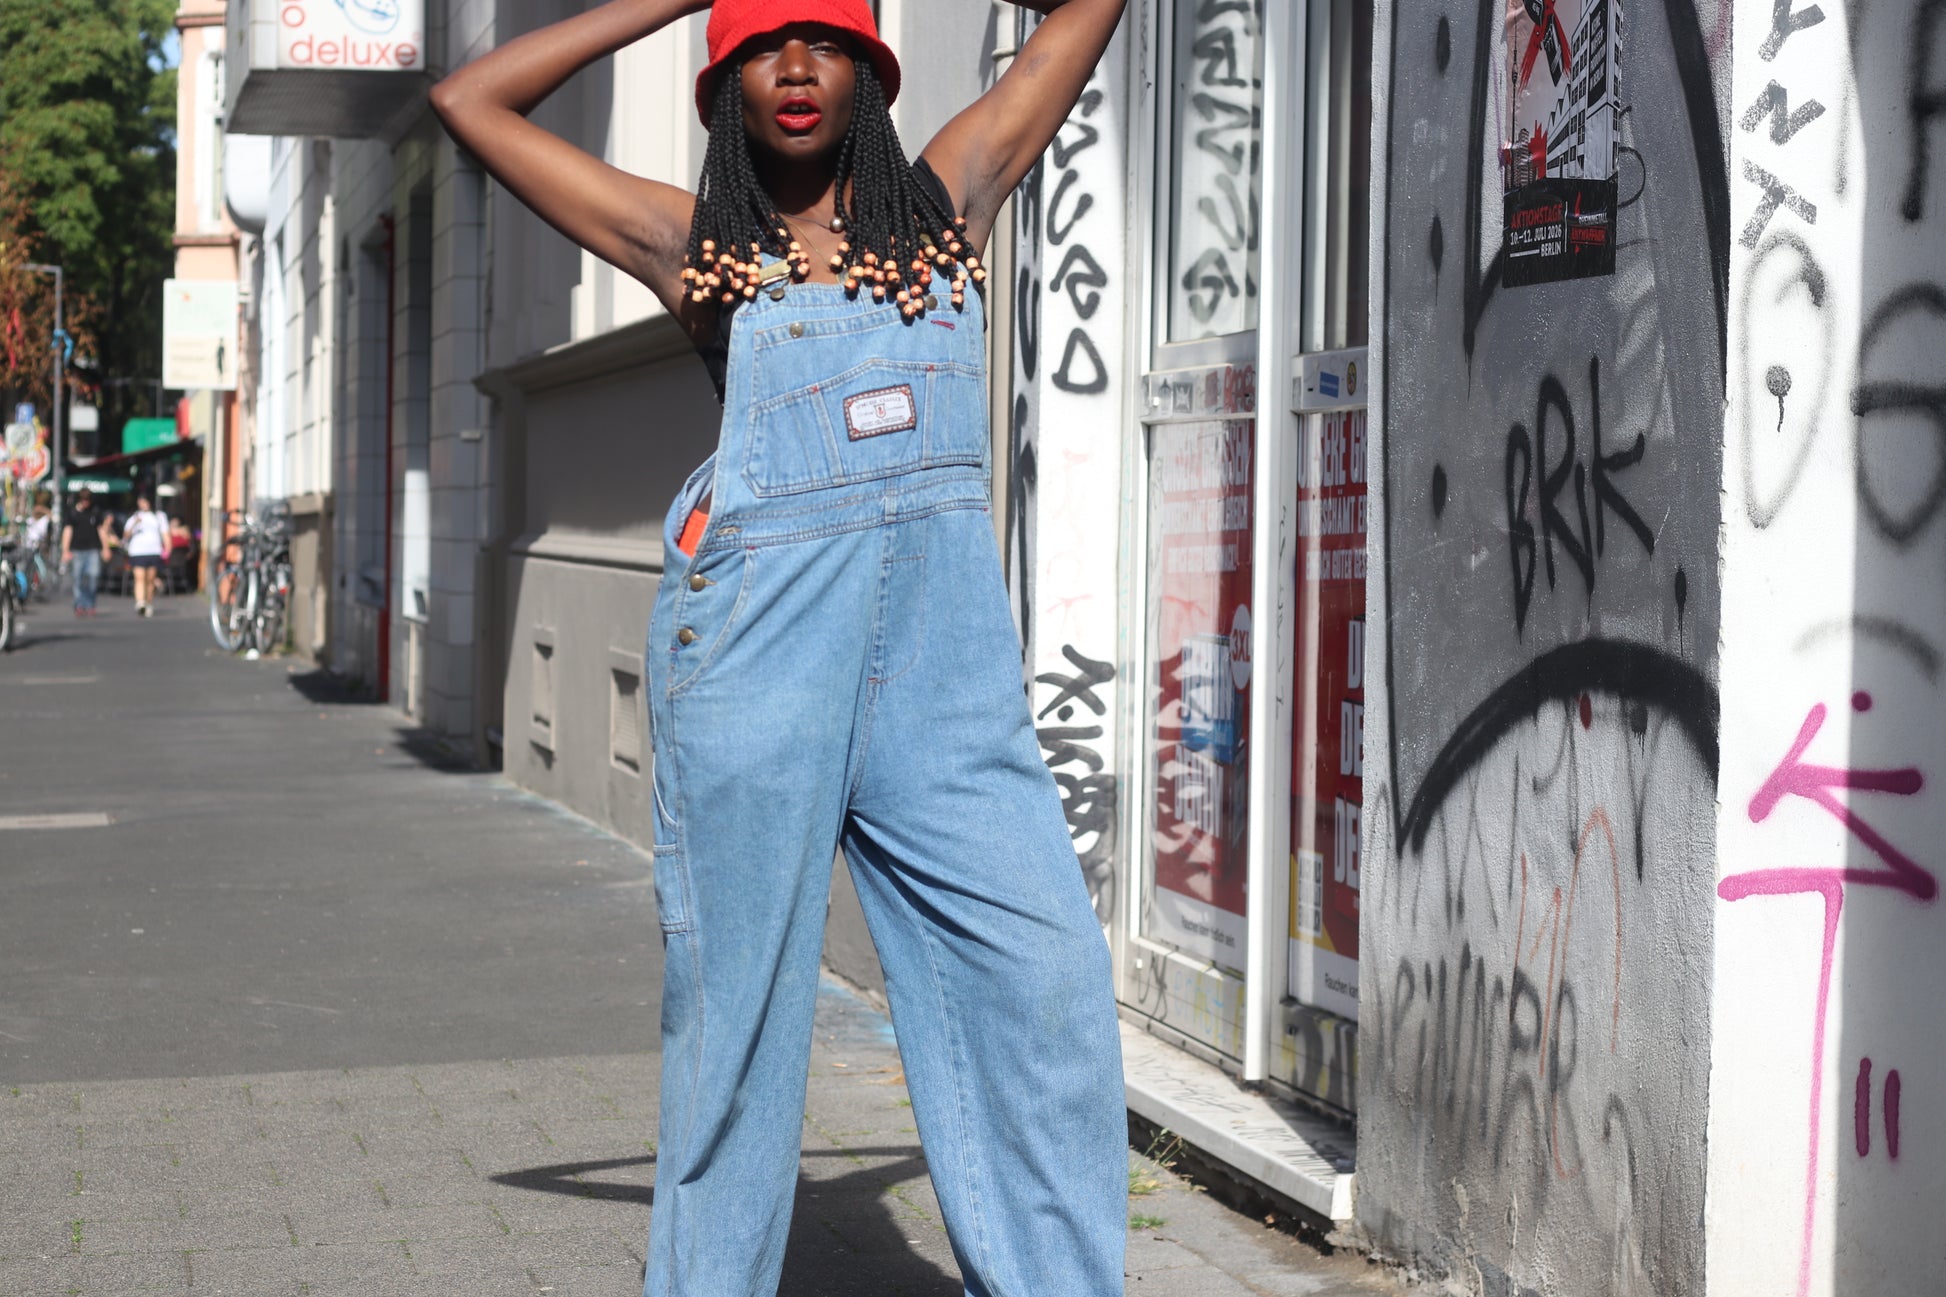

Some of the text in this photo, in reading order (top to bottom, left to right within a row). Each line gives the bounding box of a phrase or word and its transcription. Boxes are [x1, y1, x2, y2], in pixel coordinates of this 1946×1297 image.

[289, 34, 417, 66] deluxe
[1511, 203, 1563, 229] AKTIONSTAGE
[1534, 226, 1547, 242] JULI
[1547, 225, 1562, 240] 2026
[1541, 241, 1562, 257] BERLIN
[1231, 629, 1250, 663] 3XL
[1324, 972, 1348, 995] Rauchen
